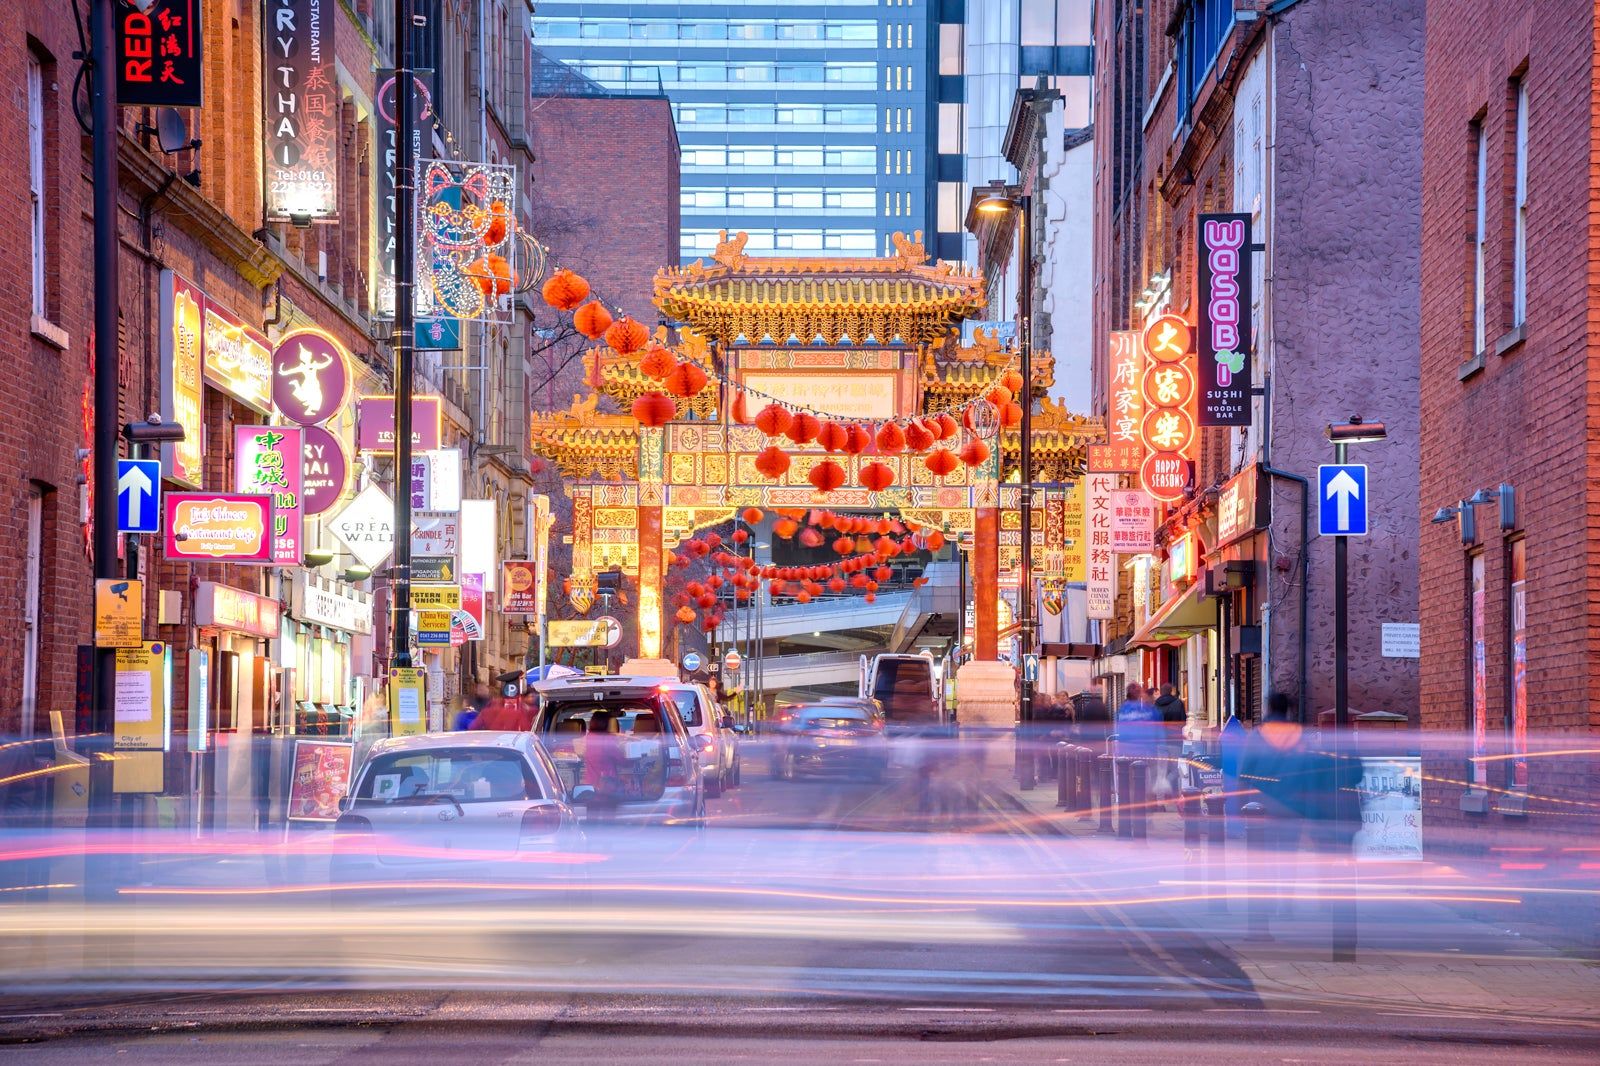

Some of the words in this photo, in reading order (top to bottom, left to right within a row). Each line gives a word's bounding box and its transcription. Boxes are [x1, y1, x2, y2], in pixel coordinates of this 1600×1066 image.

[276, 0, 296, 58] RY
[125, 13, 152, 82] RED
[277, 66, 296, 165] THAI
[298, 170, 326, 181] 0161
[271, 181, 295, 193] 22
[1207, 390, 1243, 399] SUSHI
[304, 443, 325, 459] RY
[304, 462, 329, 475] AI
[1155, 460, 1180, 474] HAPPY
[326, 480, 334, 488] &
[1151, 473, 1184, 488] SEASONS
[341, 522, 390, 532] GREA
[425, 543, 431, 552] &
[422, 620, 446, 629] Services
[571, 625, 606, 634] Diverted
[576, 633, 601, 641] traffic
[115, 648, 150, 656] Suspension
[121, 735, 135, 744] City
[135, 735, 143, 743] of
[114, 741, 149, 749] Manchester
